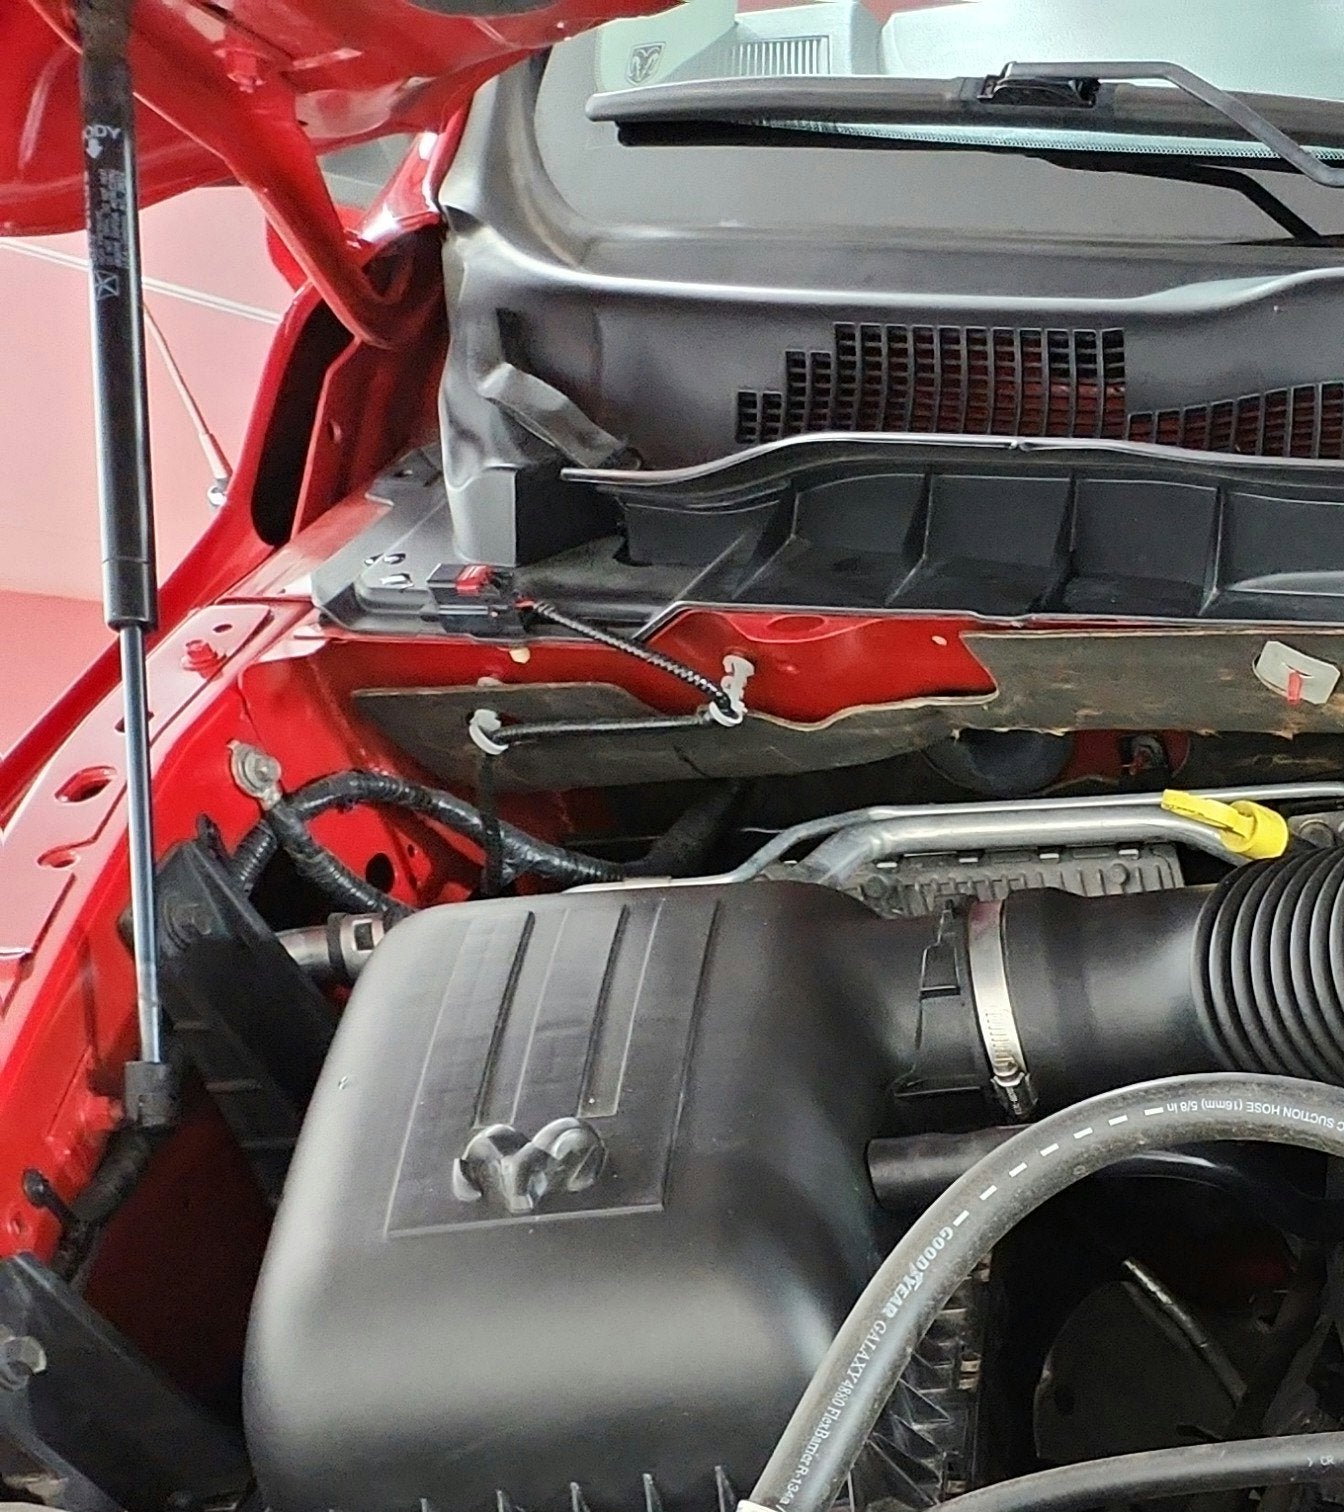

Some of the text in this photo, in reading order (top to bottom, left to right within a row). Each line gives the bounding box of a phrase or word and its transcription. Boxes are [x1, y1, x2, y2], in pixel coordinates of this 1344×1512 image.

[1167, 1104, 1178, 1114] in
[1180, 1101, 1198, 1112] 5/8
[1201, 1098, 1243, 1111] (16mm)
[1246, 1101, 1281, 1115] HOSE
[1283, 1107, 1336, 1128] SUCTION
[882, 1226, 954, 1318] GOODYEAR
[847, 1320, 887, 1384] GALAXY
[831, 1381, 854, 1407] 4880
